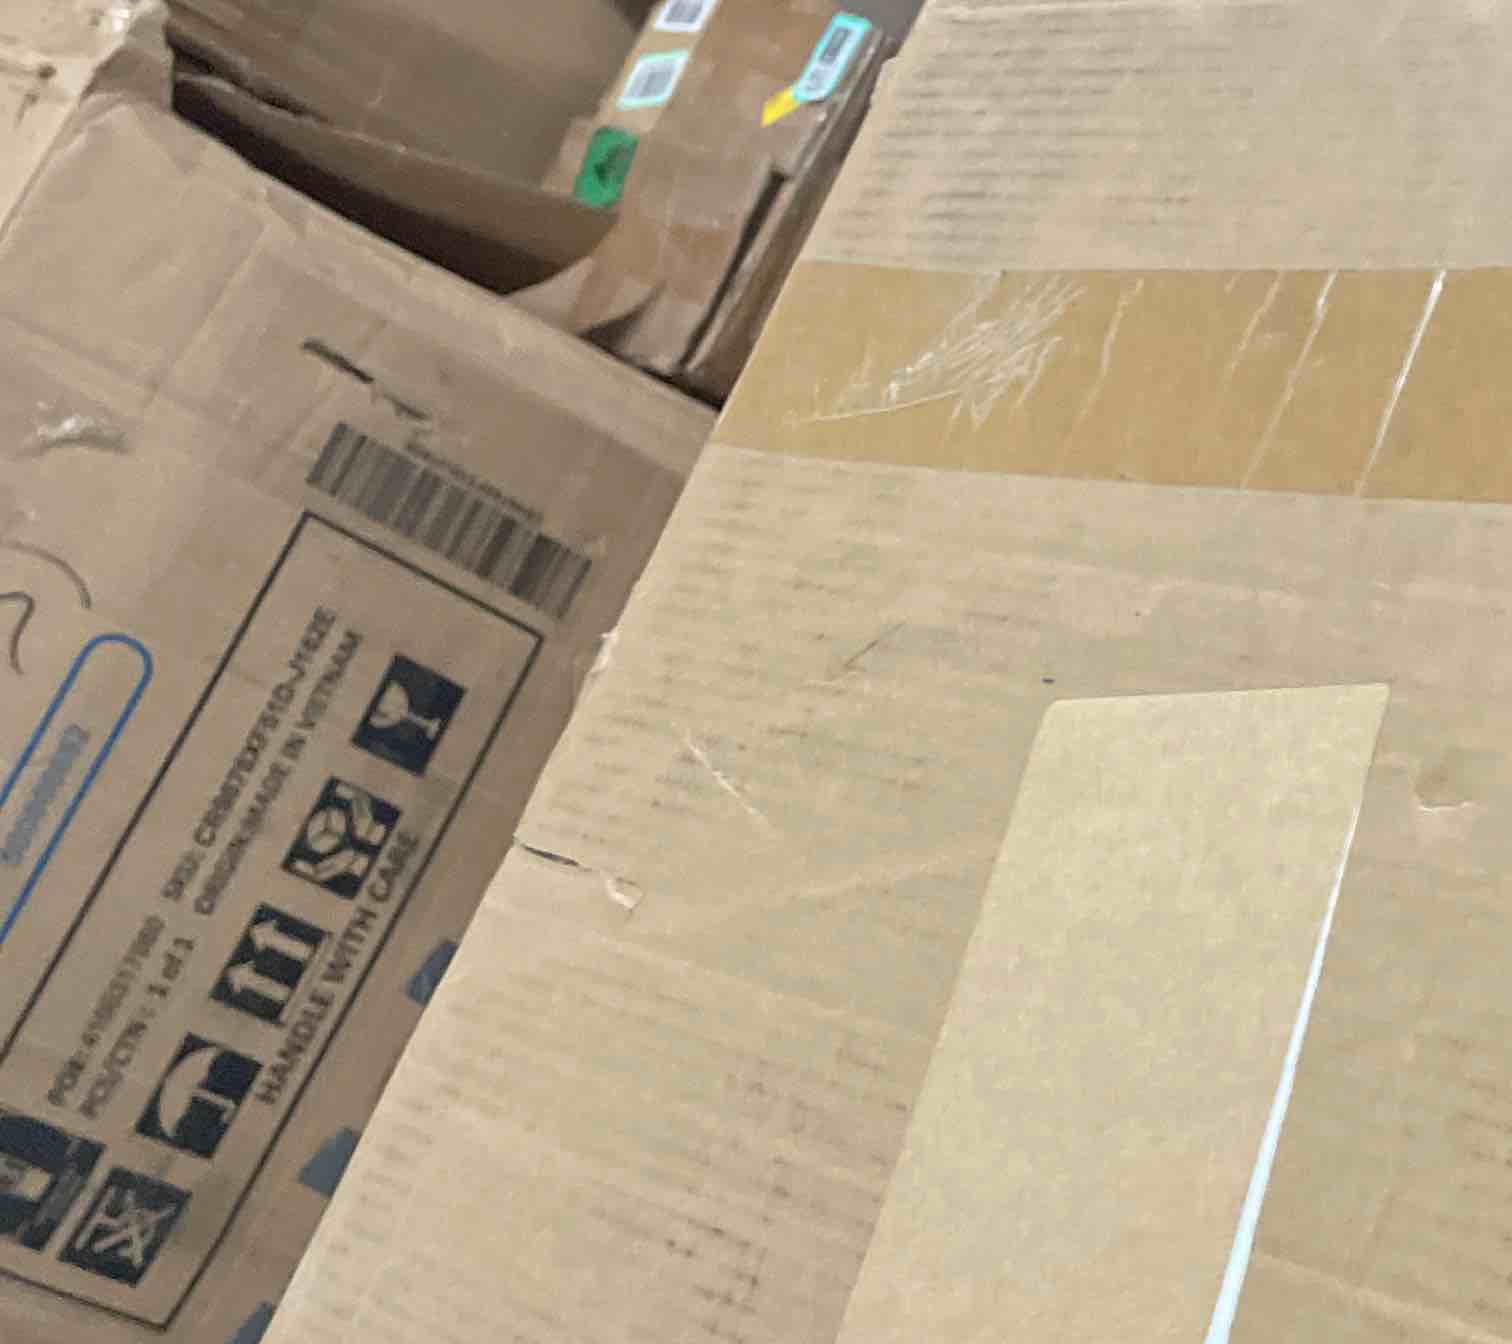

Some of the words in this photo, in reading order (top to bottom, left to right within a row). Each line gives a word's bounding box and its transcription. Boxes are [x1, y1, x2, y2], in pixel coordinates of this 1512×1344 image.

[254, 989, 335, 1106] HANDLE
[321, 907, 377, 985] WITH
[368, 830, 421, 903] CARE
